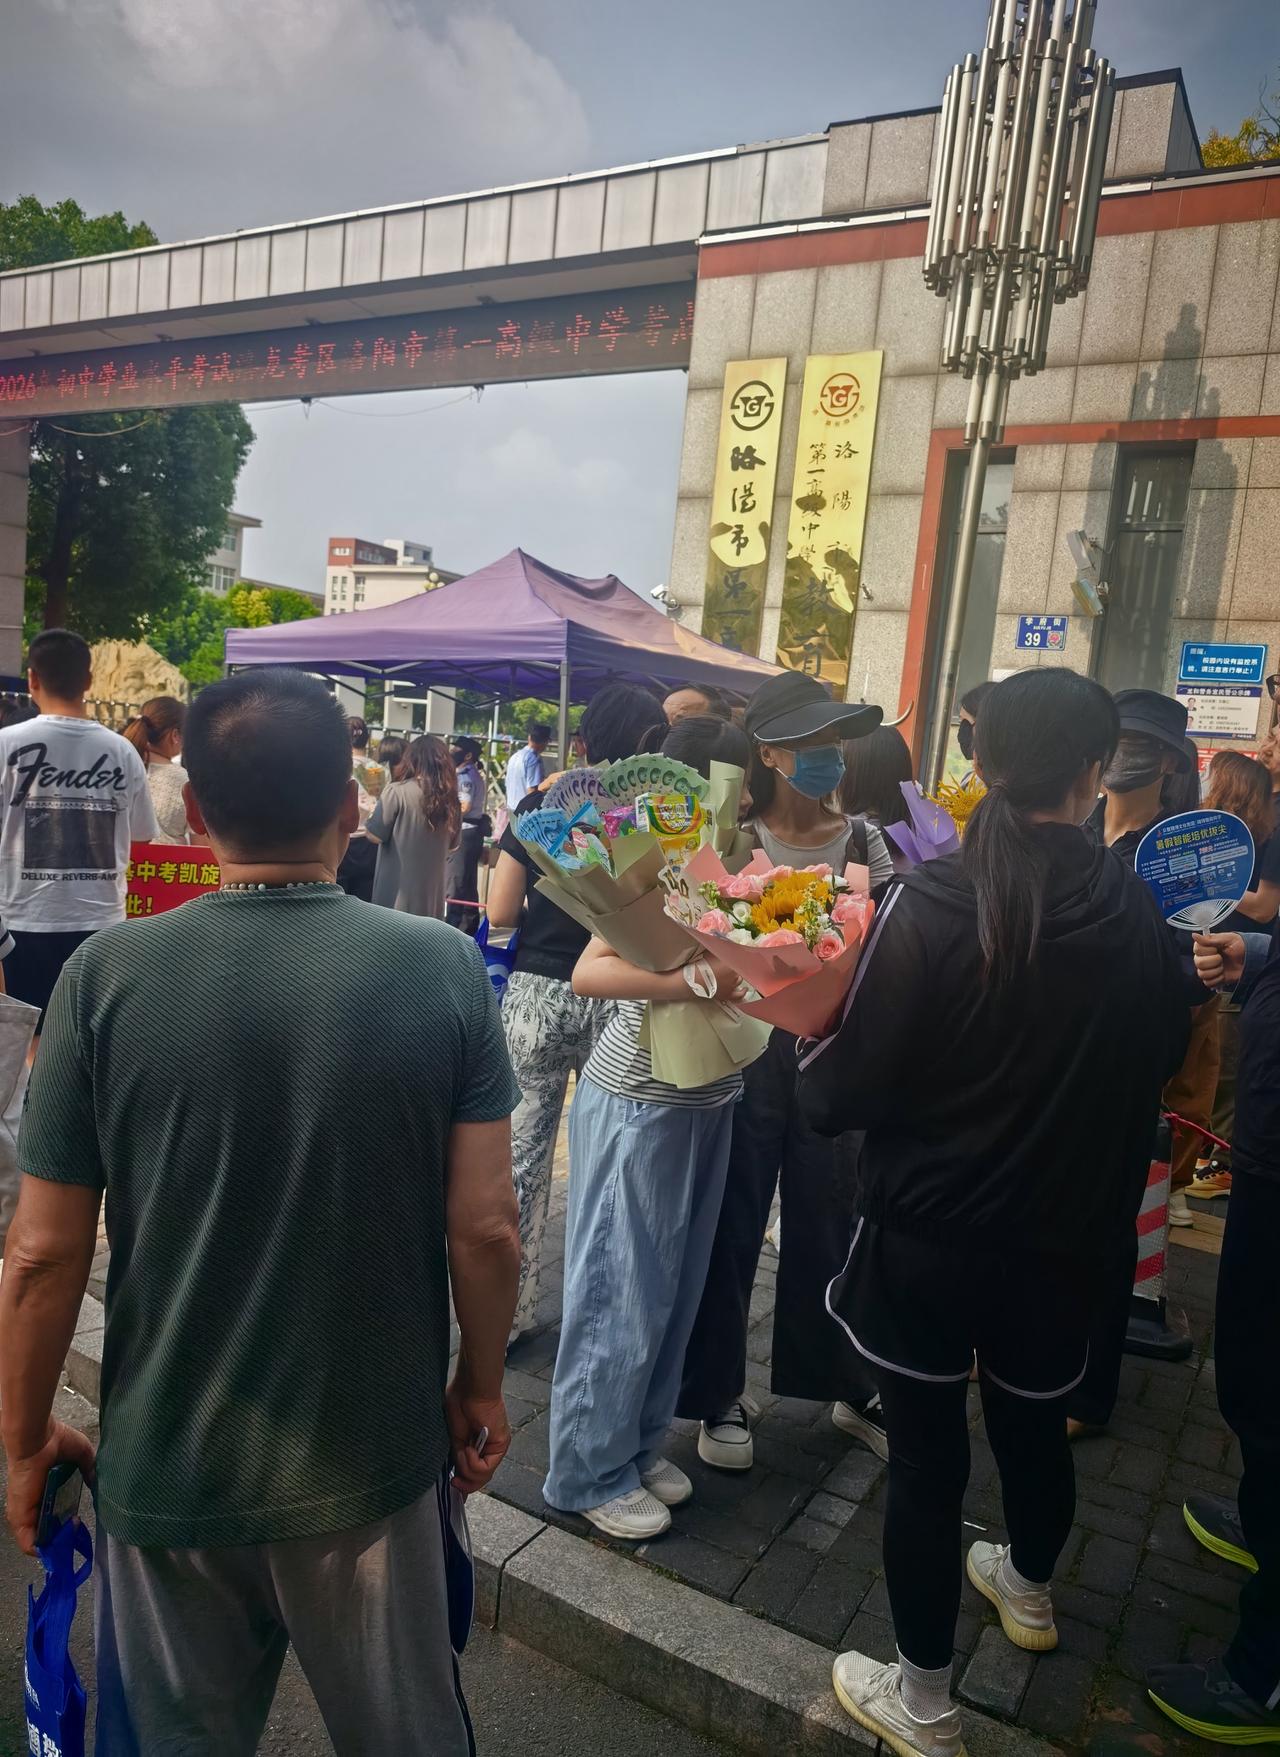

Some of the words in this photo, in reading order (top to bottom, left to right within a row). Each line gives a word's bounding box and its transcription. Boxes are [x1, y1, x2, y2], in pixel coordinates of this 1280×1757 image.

[1026, 617, 1061, 626] 学府街
[1024, 632, 1041, 647] 39
[8, 742, 127, 806] Fender
[21, 872, 59, 880] DELUXE
